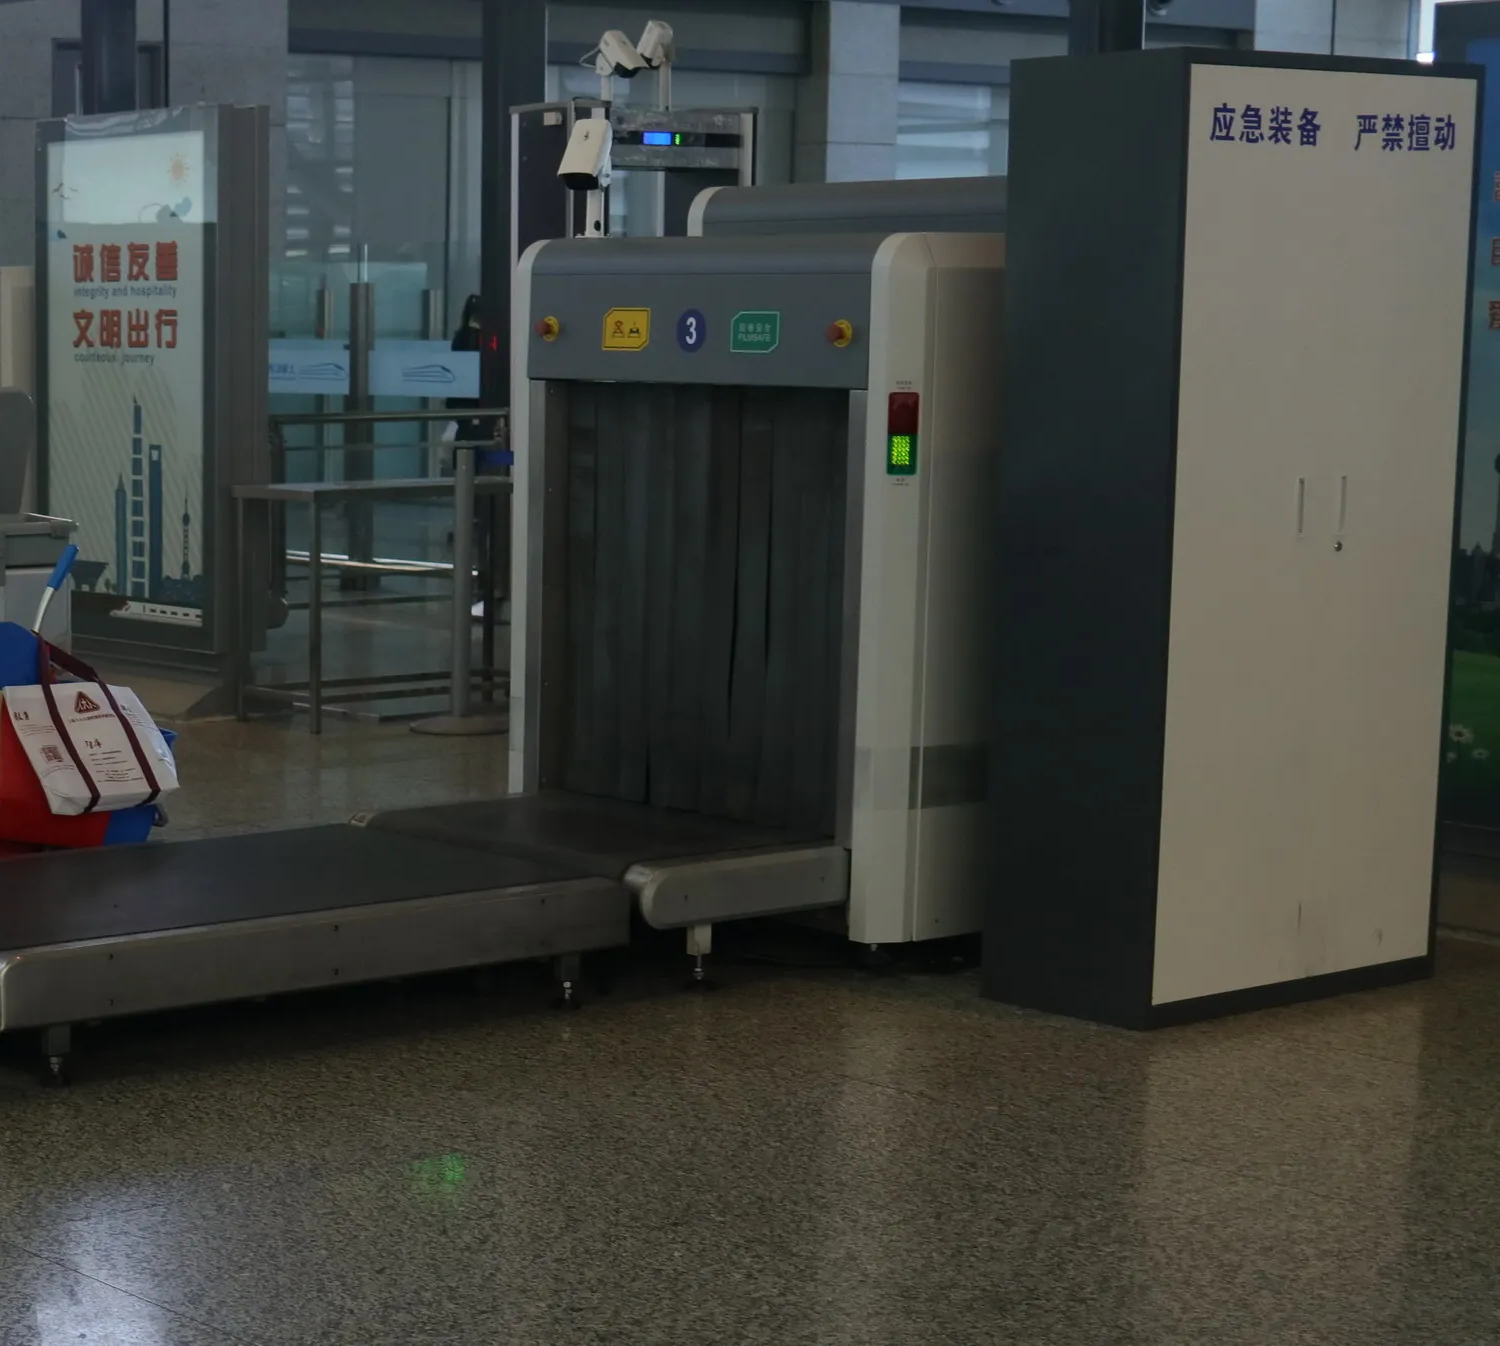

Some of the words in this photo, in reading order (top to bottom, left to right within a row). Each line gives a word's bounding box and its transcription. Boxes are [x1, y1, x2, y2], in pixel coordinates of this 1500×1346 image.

[1209, 102, 1321, 147] 应急装备
[1354, 113, 1456, 151] 严禁擅动
[72, 240, 178, 283] 诚信友善
[112, 286, 128, 297] and
[72, 308, 178, 349] 文明出行
[685, 316, 698, 345] 3
